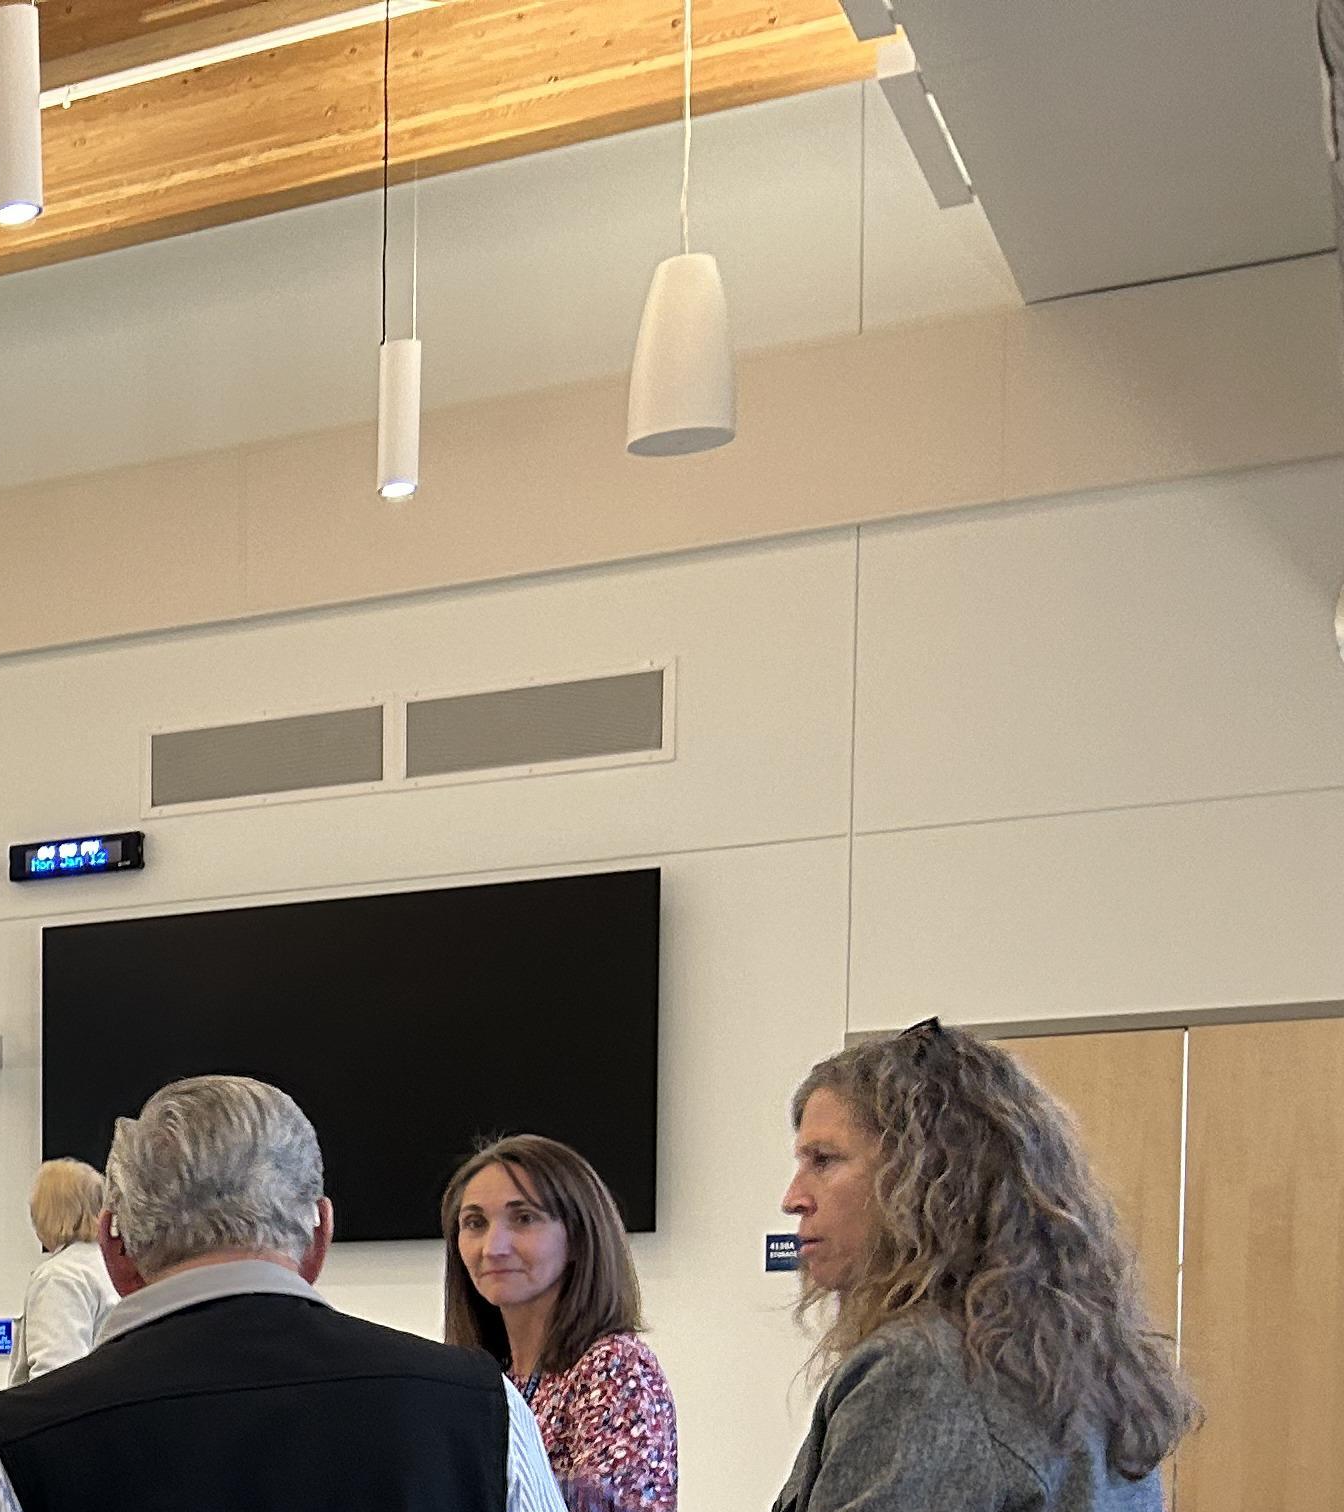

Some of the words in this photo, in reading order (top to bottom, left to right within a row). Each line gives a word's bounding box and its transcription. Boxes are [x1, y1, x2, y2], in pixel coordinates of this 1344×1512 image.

[31, 859, 55, 872] Mon
[60, 856, 83, 868] Jan
[89, 852, 107, 866] 12
